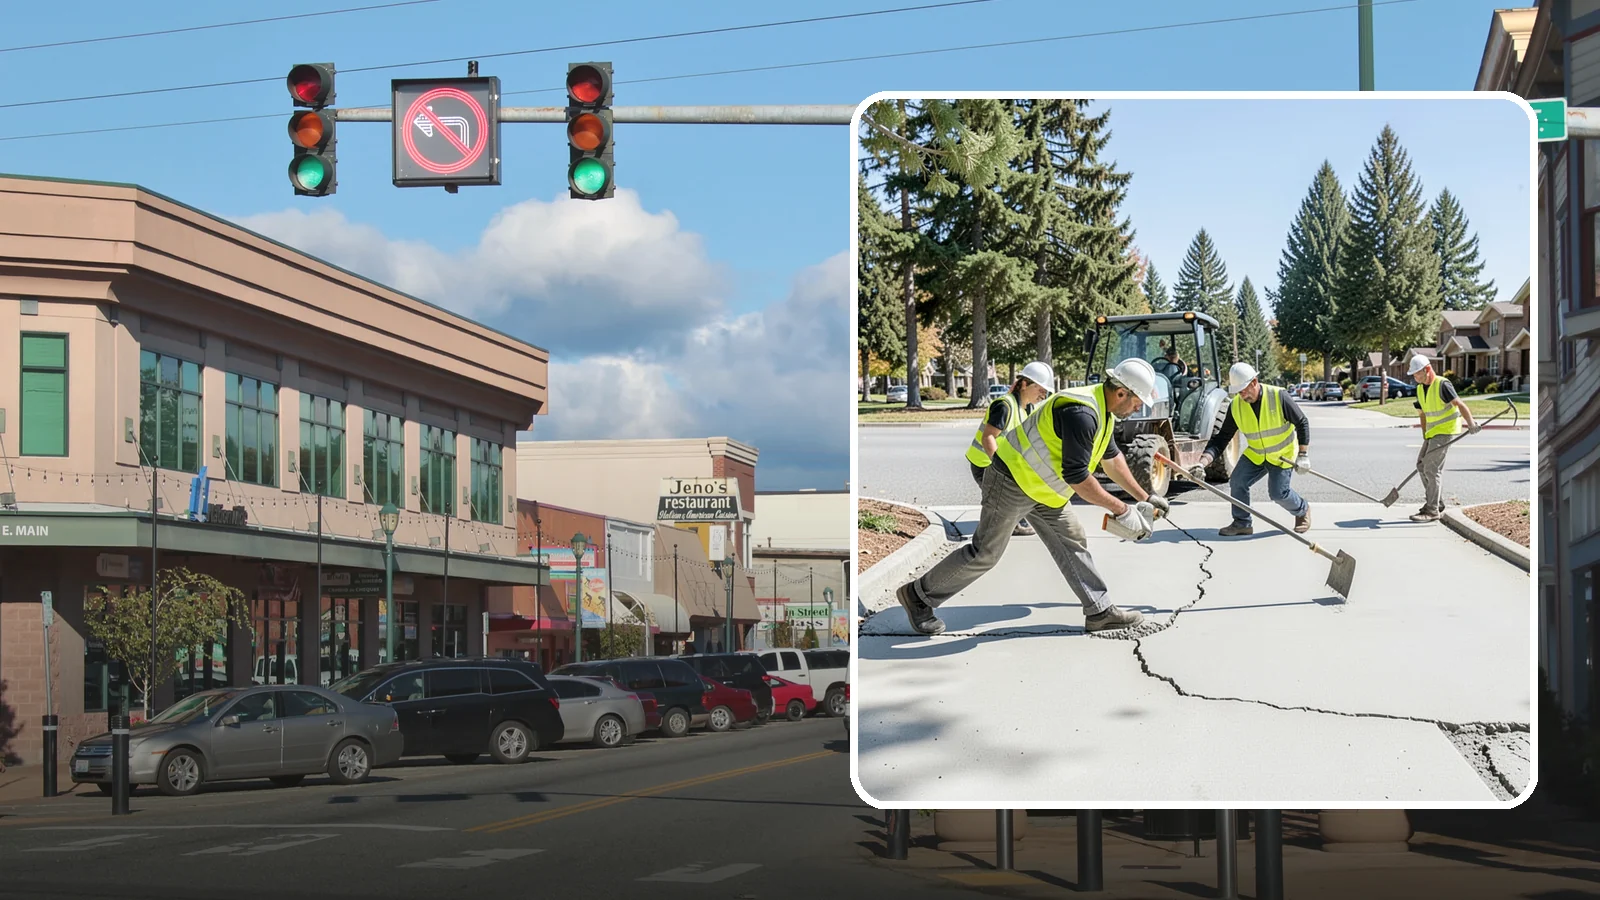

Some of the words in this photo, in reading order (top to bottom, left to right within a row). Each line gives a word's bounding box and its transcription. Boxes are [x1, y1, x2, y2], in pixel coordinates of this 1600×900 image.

[670, 480, 727, 494] Jeno's
[665, 496, 731, 509] restaurant
[686, 509, 714, 519] American
[715, 509, 737, 519] Cuisine
[2, 525, 13, 536] E.
[15, 525, 49, 536] MAIN
[797, 607, 829, 616] Street
[791, 619, 824, 627] lass
